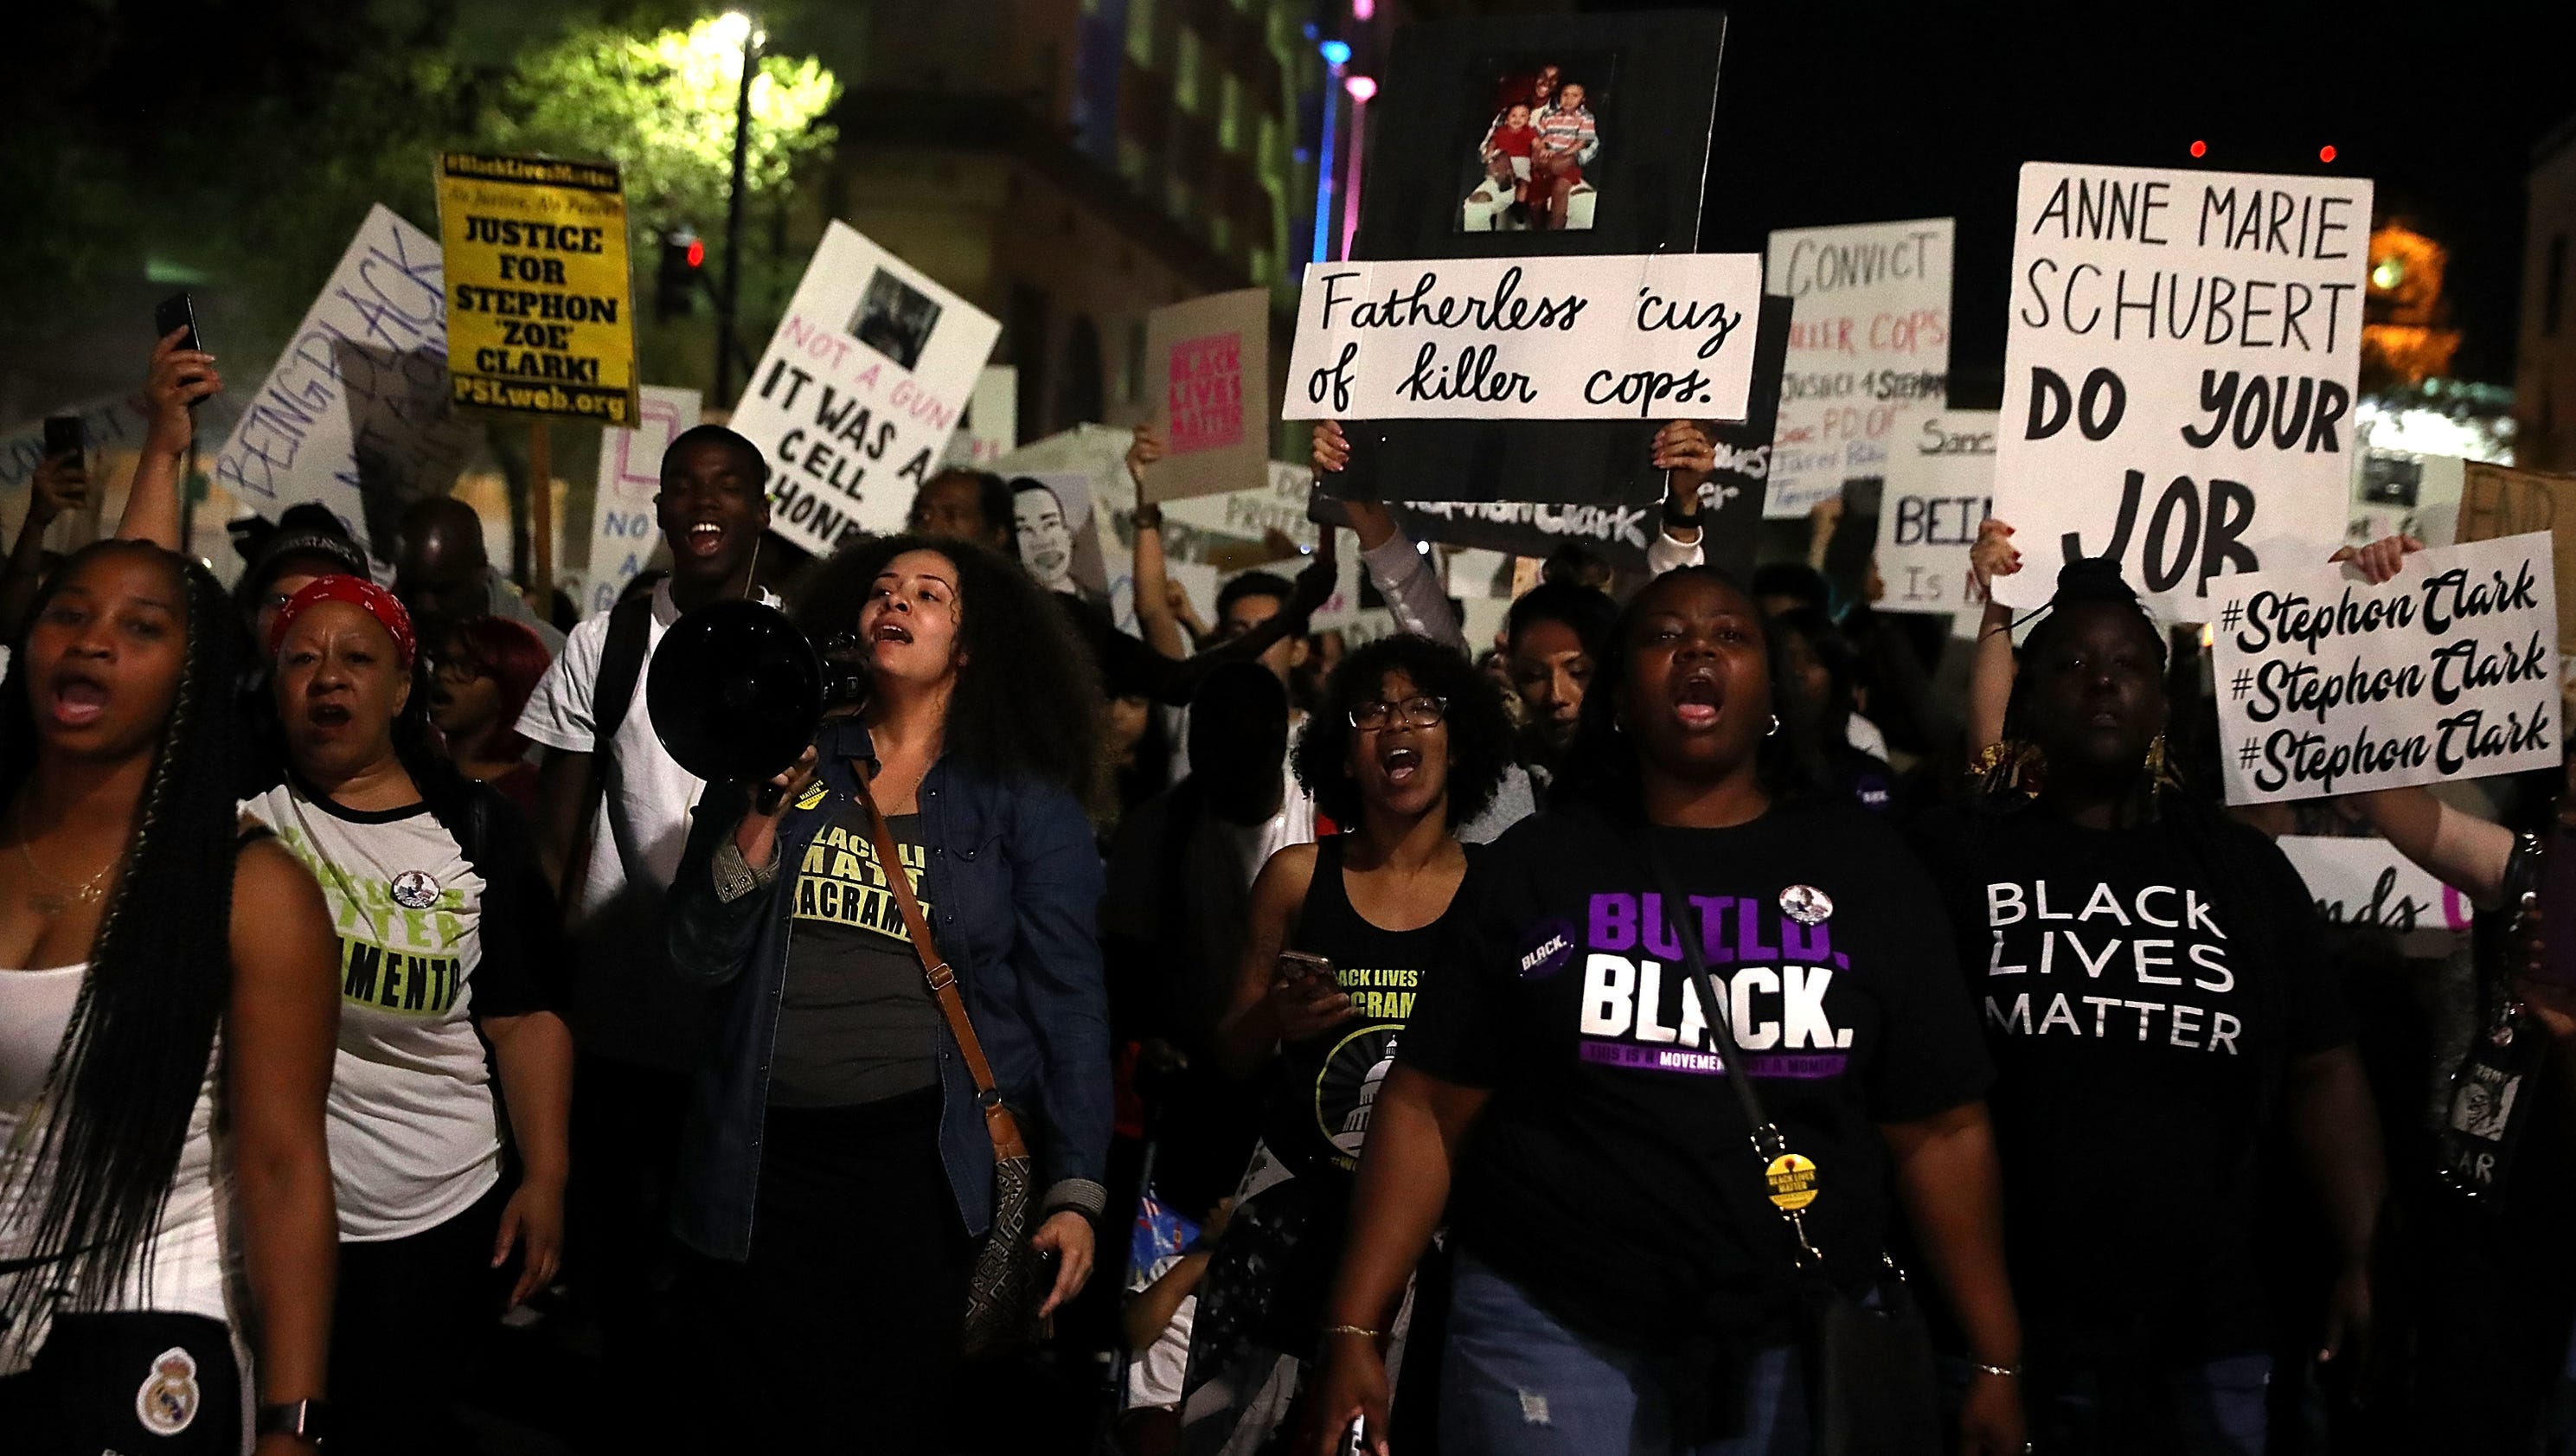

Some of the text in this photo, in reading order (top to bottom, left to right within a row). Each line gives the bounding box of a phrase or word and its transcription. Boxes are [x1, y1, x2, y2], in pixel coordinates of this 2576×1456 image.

[465, 215, 603, 253] JUSTICE
[2032, 177, 2353, 260] ANNE MARIE
[499, 254, 566, 285] FOR
[1787, 231, 1939, 298] CONVICT
[456, 284, 618, 324] STEPHON
[1321, 266, 1588, 331] Fatherless
[2021, 258, 2355, 354] SCHUBERT
[477, 349, 599, 382] CLARK!
[781, 315, 955, 431] NOT A GUN
[1308, 342, 1712, 418] of killer cops.
[454, 375, 626, 421] PSLweb.org
[760, 358, 816, 412] IT
[815, 384, 897, 460] WAS
[897, 446, 932, 487] A
[2025, 366, 2349, 453] DO YOUR
[778, 428, 868, 502] CELL
[1894, 495, 1994, 546] BEI
[1986, 880, 2228, 940] BLACK
[1375, 969, 1418, 987] LIVES
[1521, 933, 1567, 972] BLACK.
[1989, 930, 2235, 993] LIVES
[1580, 953, 1854, 1050] BLACK.
[1985, 993, 2242, 1055] MATTER
